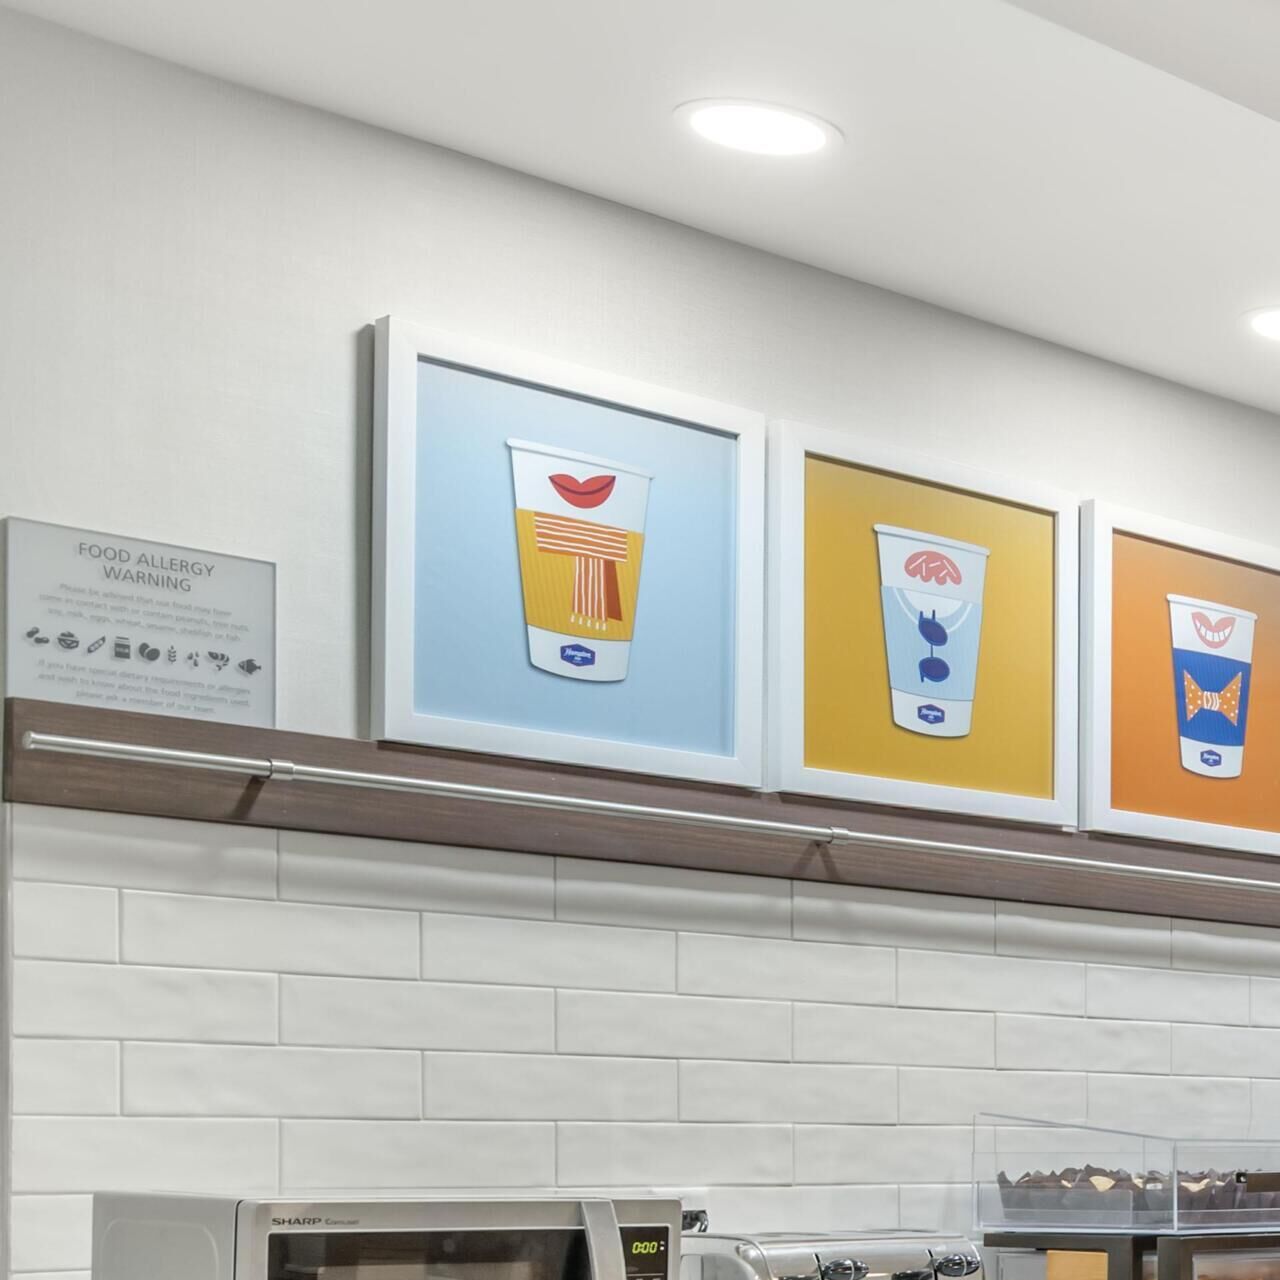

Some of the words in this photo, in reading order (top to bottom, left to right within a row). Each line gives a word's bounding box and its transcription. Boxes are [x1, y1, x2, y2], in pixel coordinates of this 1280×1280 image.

[78, 542, 131, 563] FOOD
[137, 552, 215, 577] ALLERGY
[103, 564, 192, 592] WARNING
[271, 1217, 322, 1226] SHARP
[632, 1242, 658, 1254] 0:00
